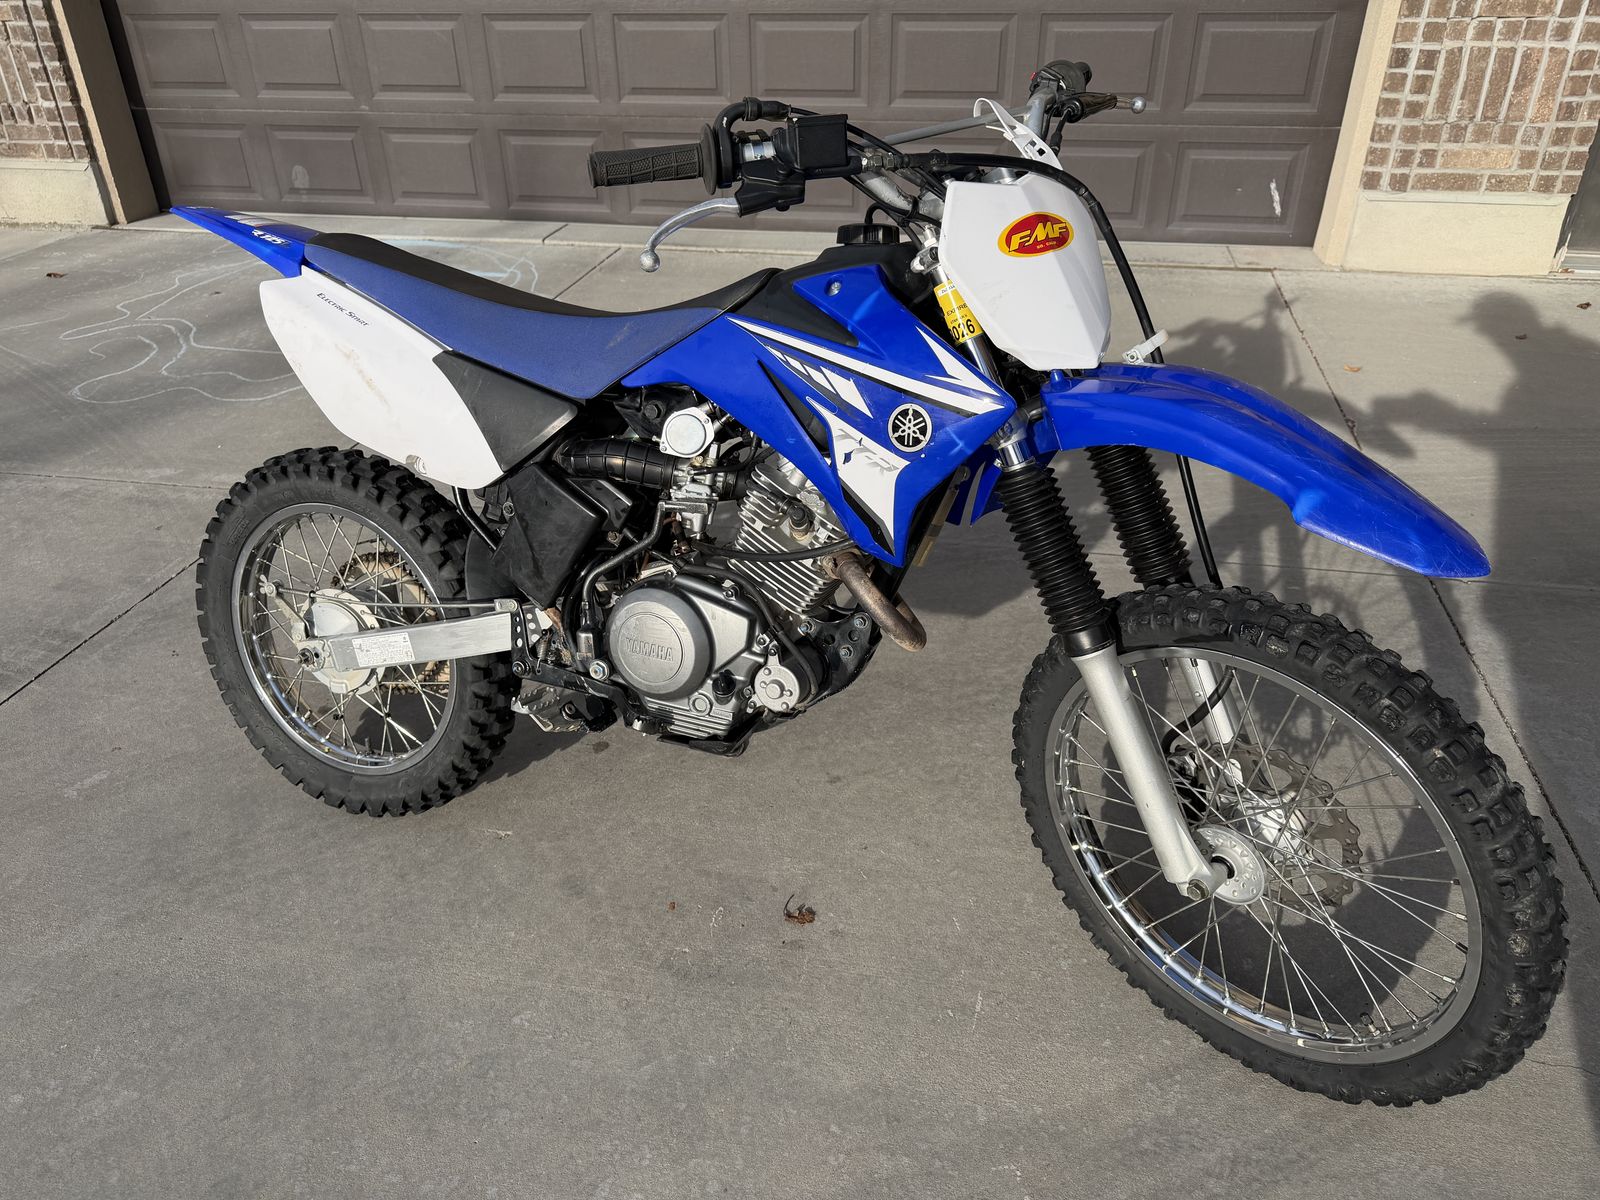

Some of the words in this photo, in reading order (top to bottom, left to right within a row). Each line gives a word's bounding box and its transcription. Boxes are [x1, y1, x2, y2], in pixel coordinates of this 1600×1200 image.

[1009, 221, 1067, 252] FMF
[949, 318, 976, 341] 026
[624, 637, 674, 662] YAMAHA
